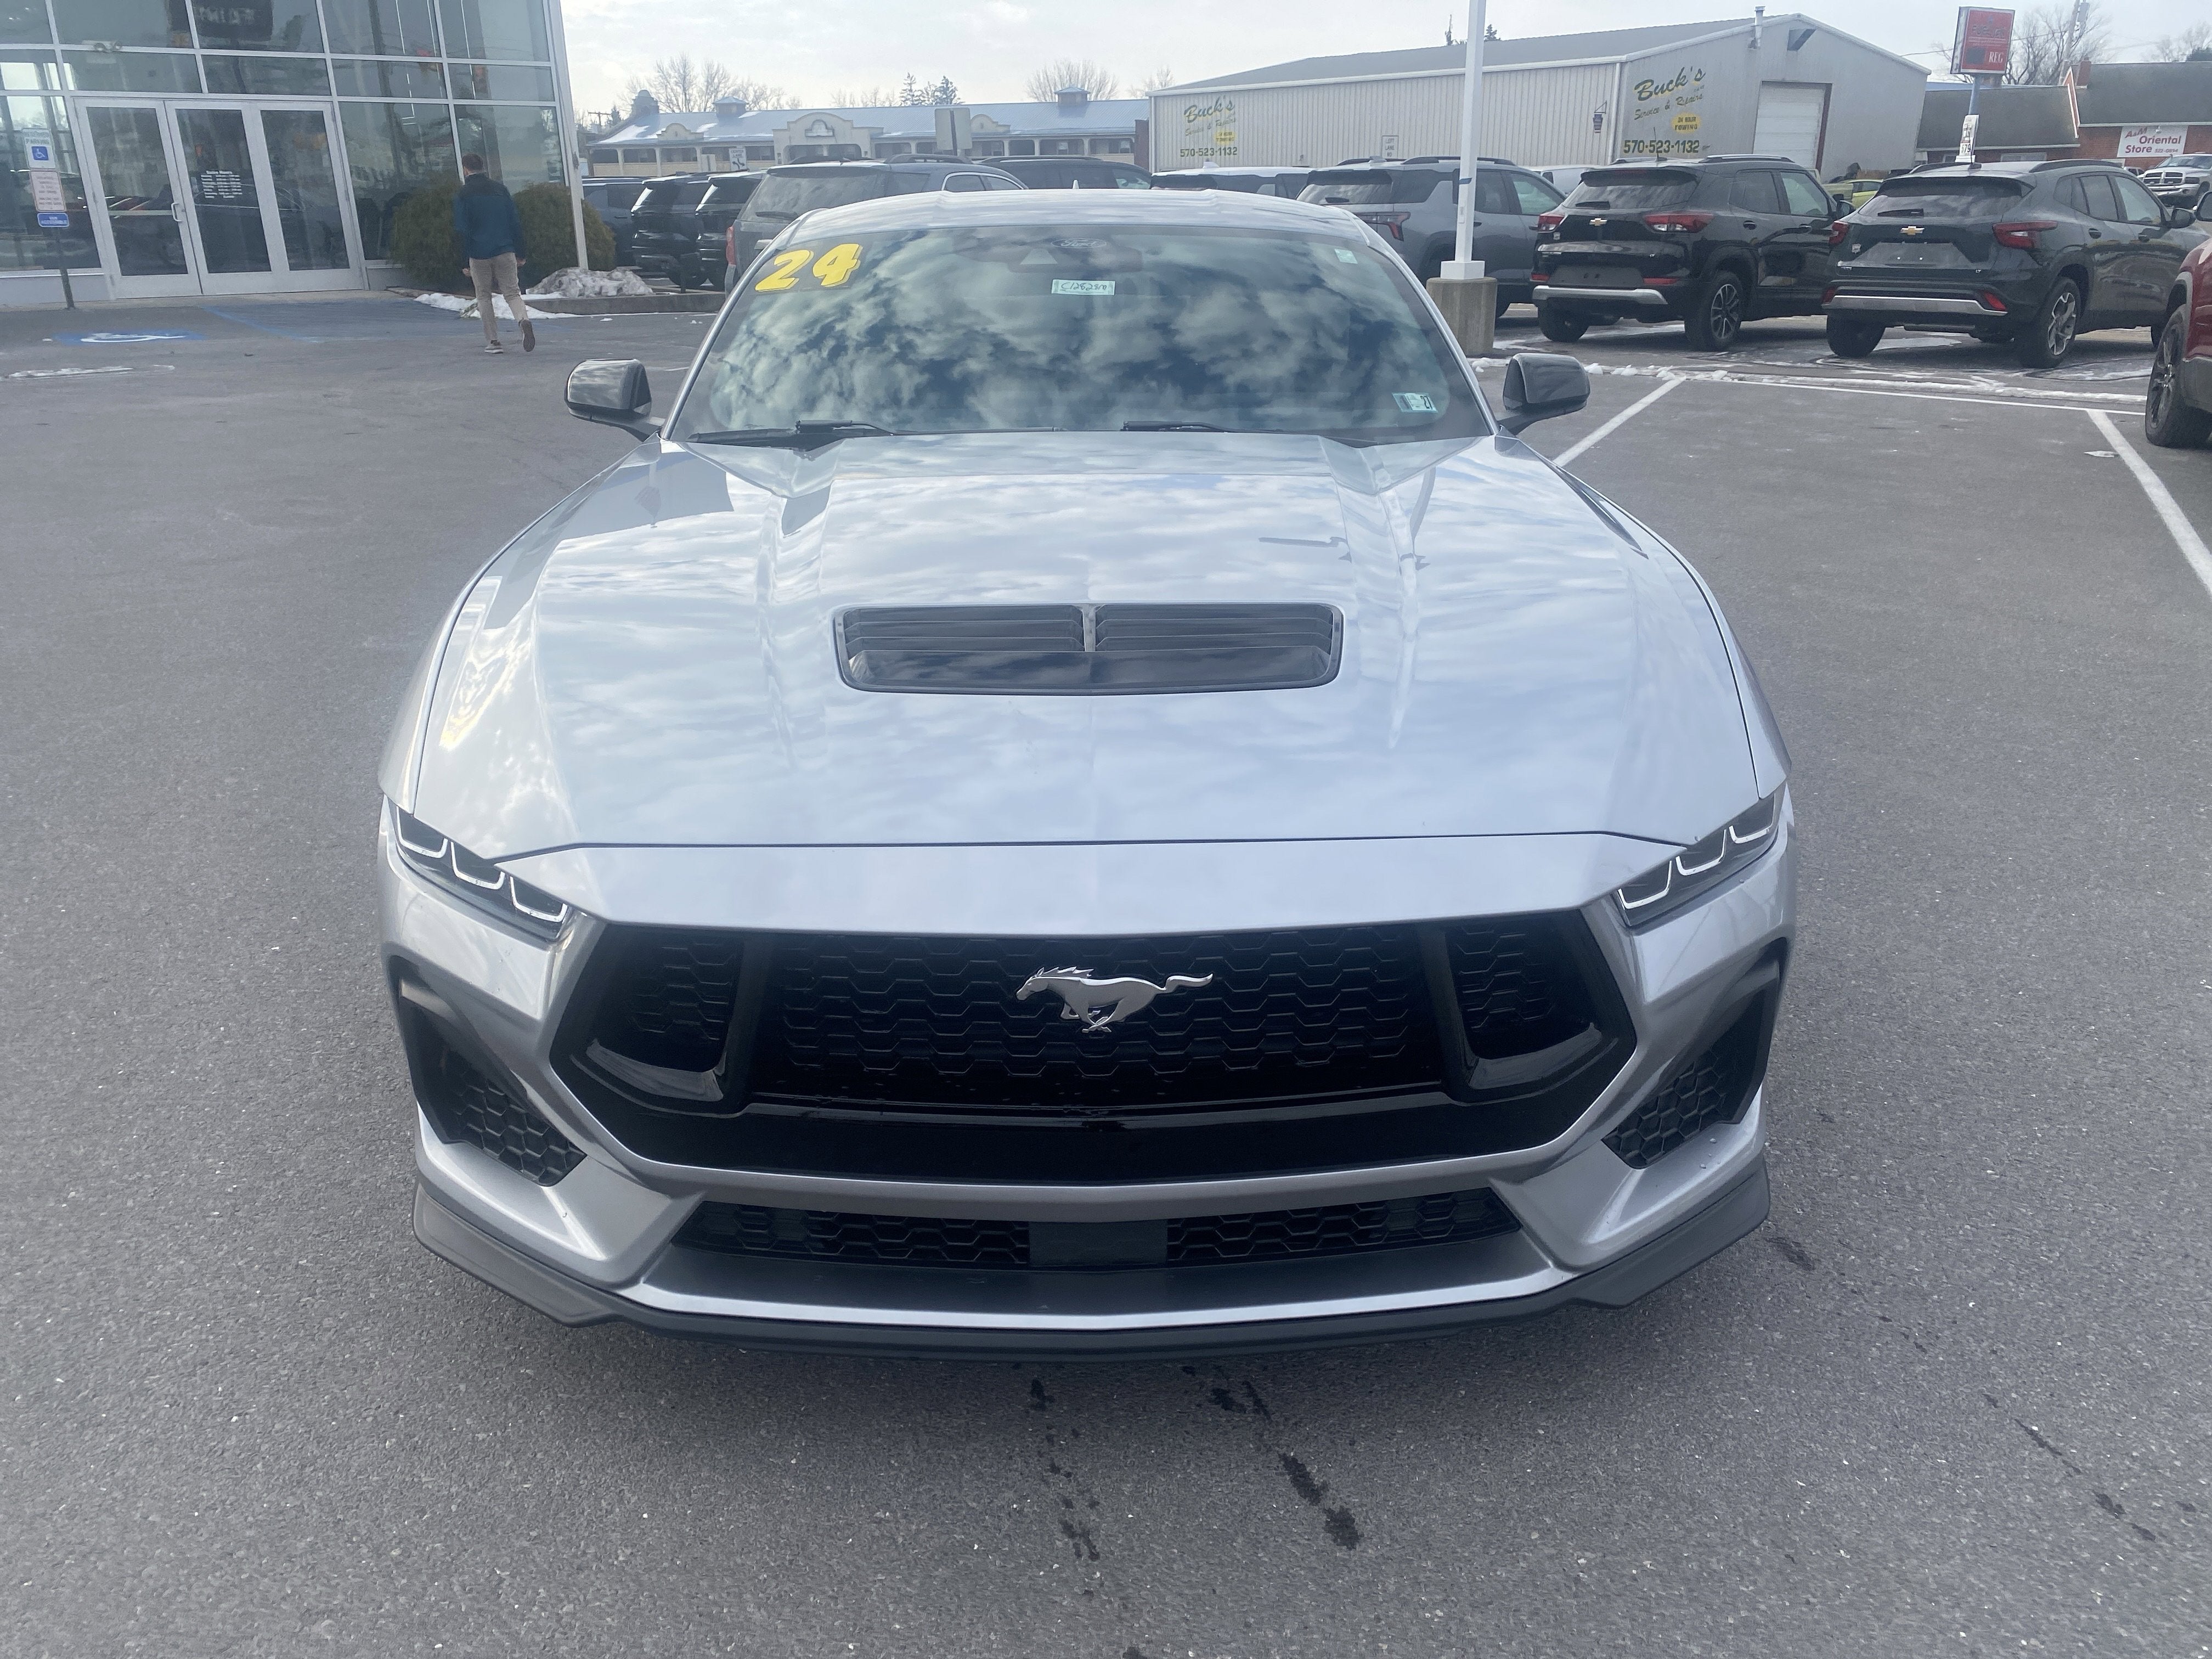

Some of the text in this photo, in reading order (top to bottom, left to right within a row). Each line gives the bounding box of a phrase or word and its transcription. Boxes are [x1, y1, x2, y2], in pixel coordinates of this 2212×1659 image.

[1989, 52, 2004, 63] REG
[1634, 66, 1706, 101] Buck's
[1184, 95, 1235, 123] Buck's
[1634, 108, 1660, 120] Service
[1675, 93, 1703, 106] Repairs
[1623, 139, 1700, 154] 570-523-1132
[2140, 136, 2181, 144] Oriental
[1180, 146, 1238, 157] 570-523-1132
[2125, 145, 2152, 153] Store
[754, 242, 864, 292] 24
